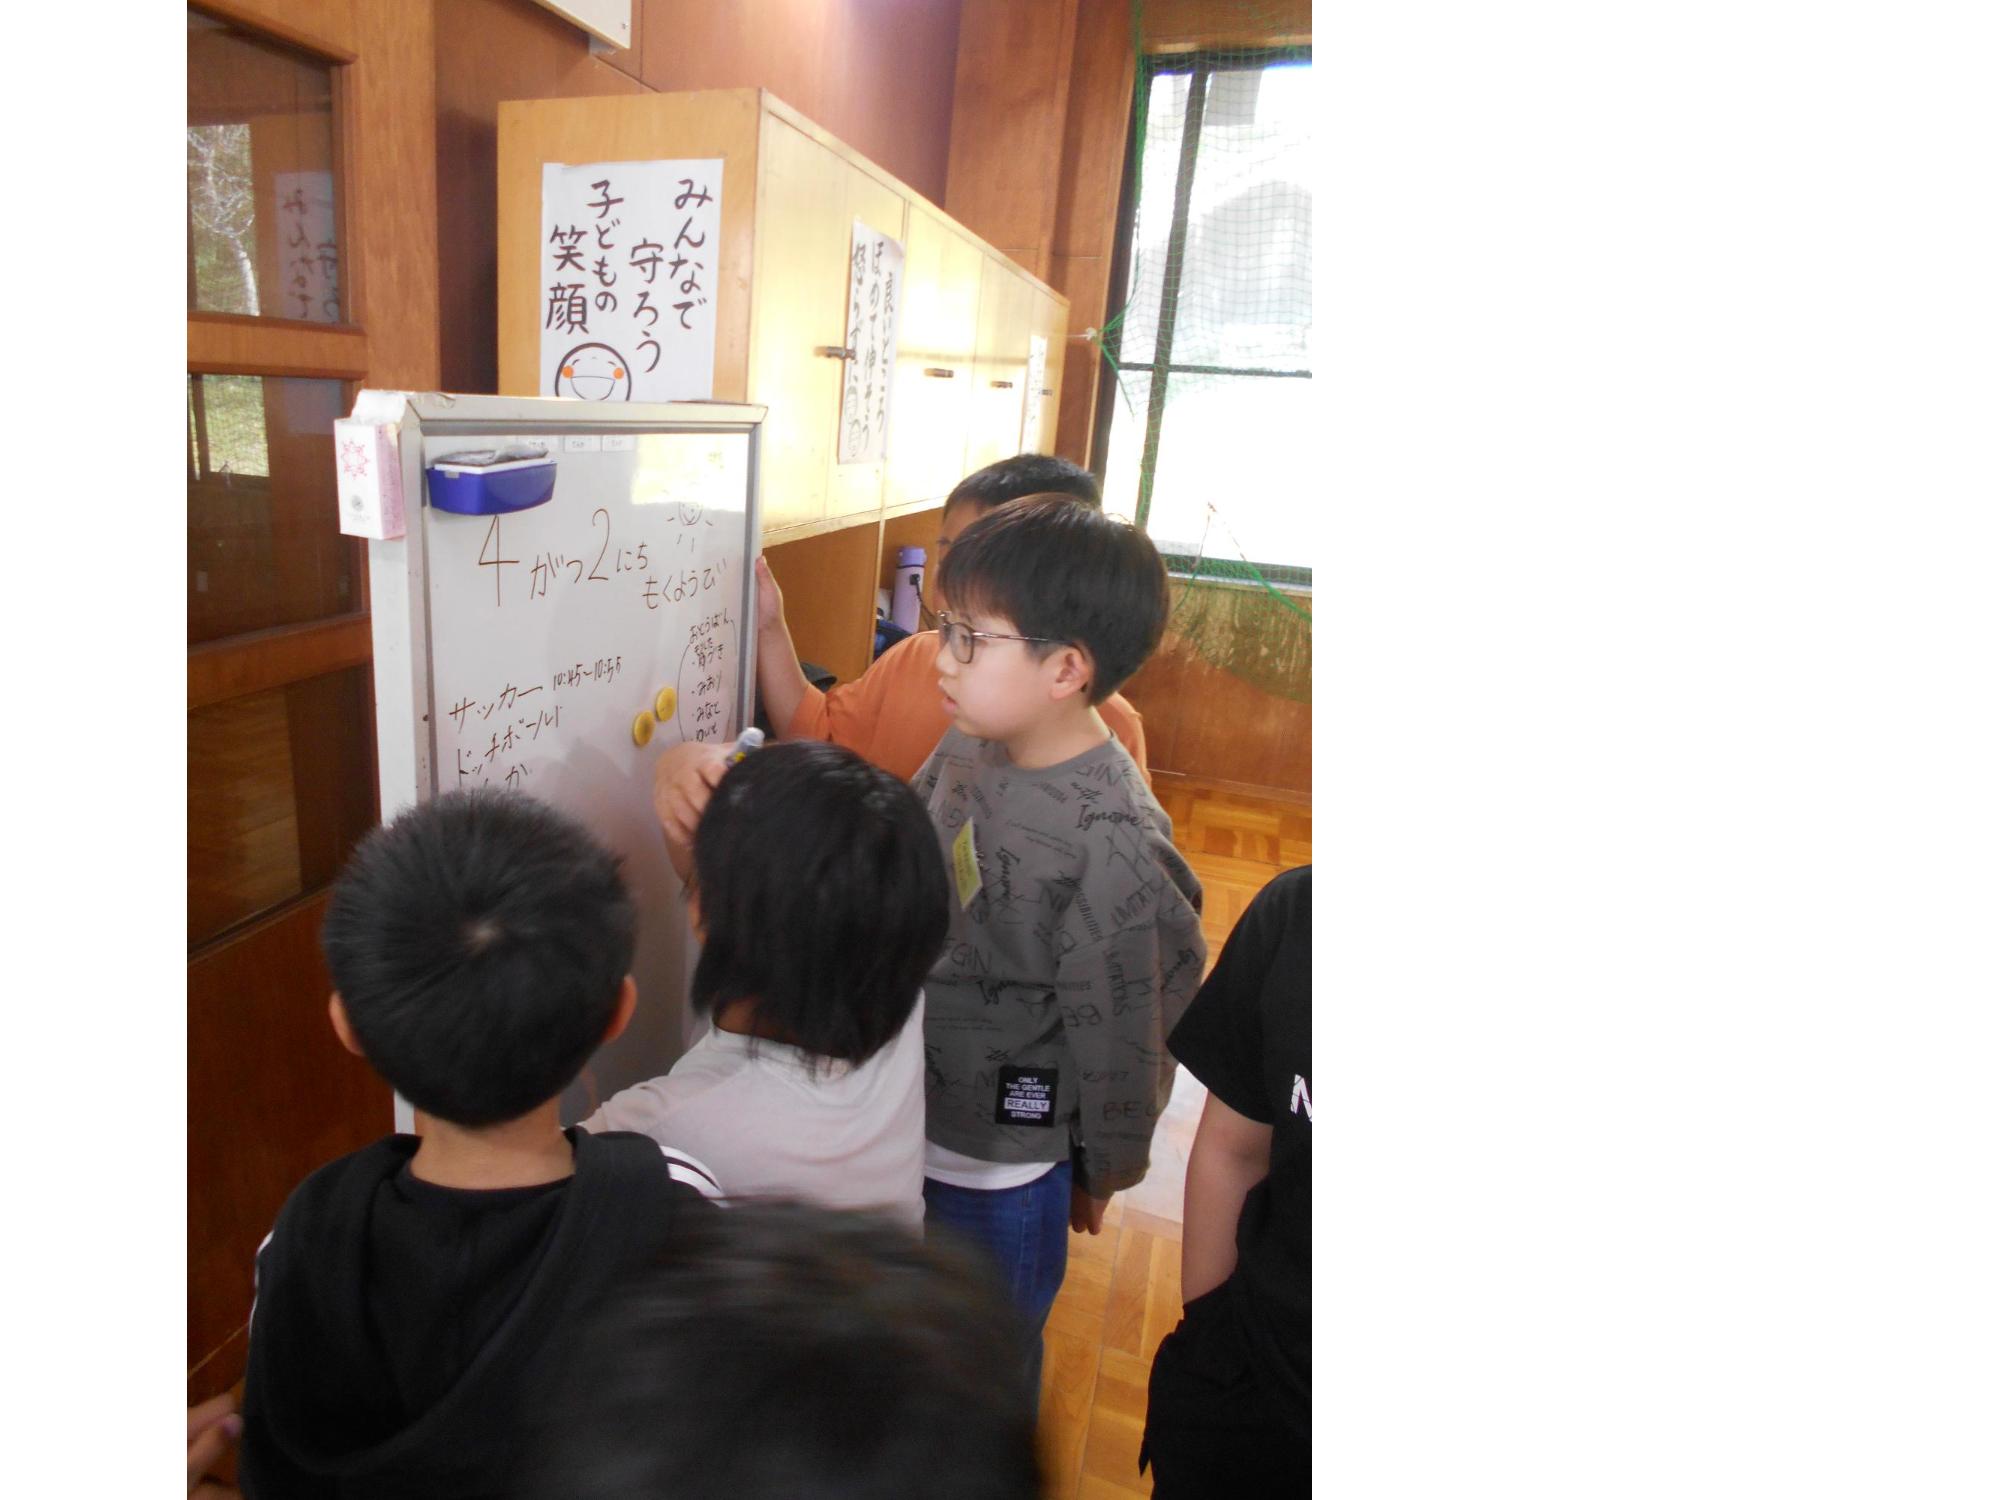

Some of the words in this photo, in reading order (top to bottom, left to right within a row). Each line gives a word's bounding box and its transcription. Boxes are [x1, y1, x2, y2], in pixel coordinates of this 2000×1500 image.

[587, 179, 625, 313] 子どもの
[669, 178, 713, 330] みんなで
[546, 224, 589, 335] 笑顔
[629, 238, 664, 373] 守ろう
[641, 557, 728, 609] もくようび
[449, 683, 543, 735] サッカー
[1006, 1099, 1049, 1110] REALLY
[1009, 1090, 1025, 1098] ARE
[1026, 1091, 1046, 1099] EVER
[1018, 1076, 1038, 1084] ONLY
[1021, 1084, 1050, 1092] GENTLE
[1010, 1111, 1042, 1119] STRONG
